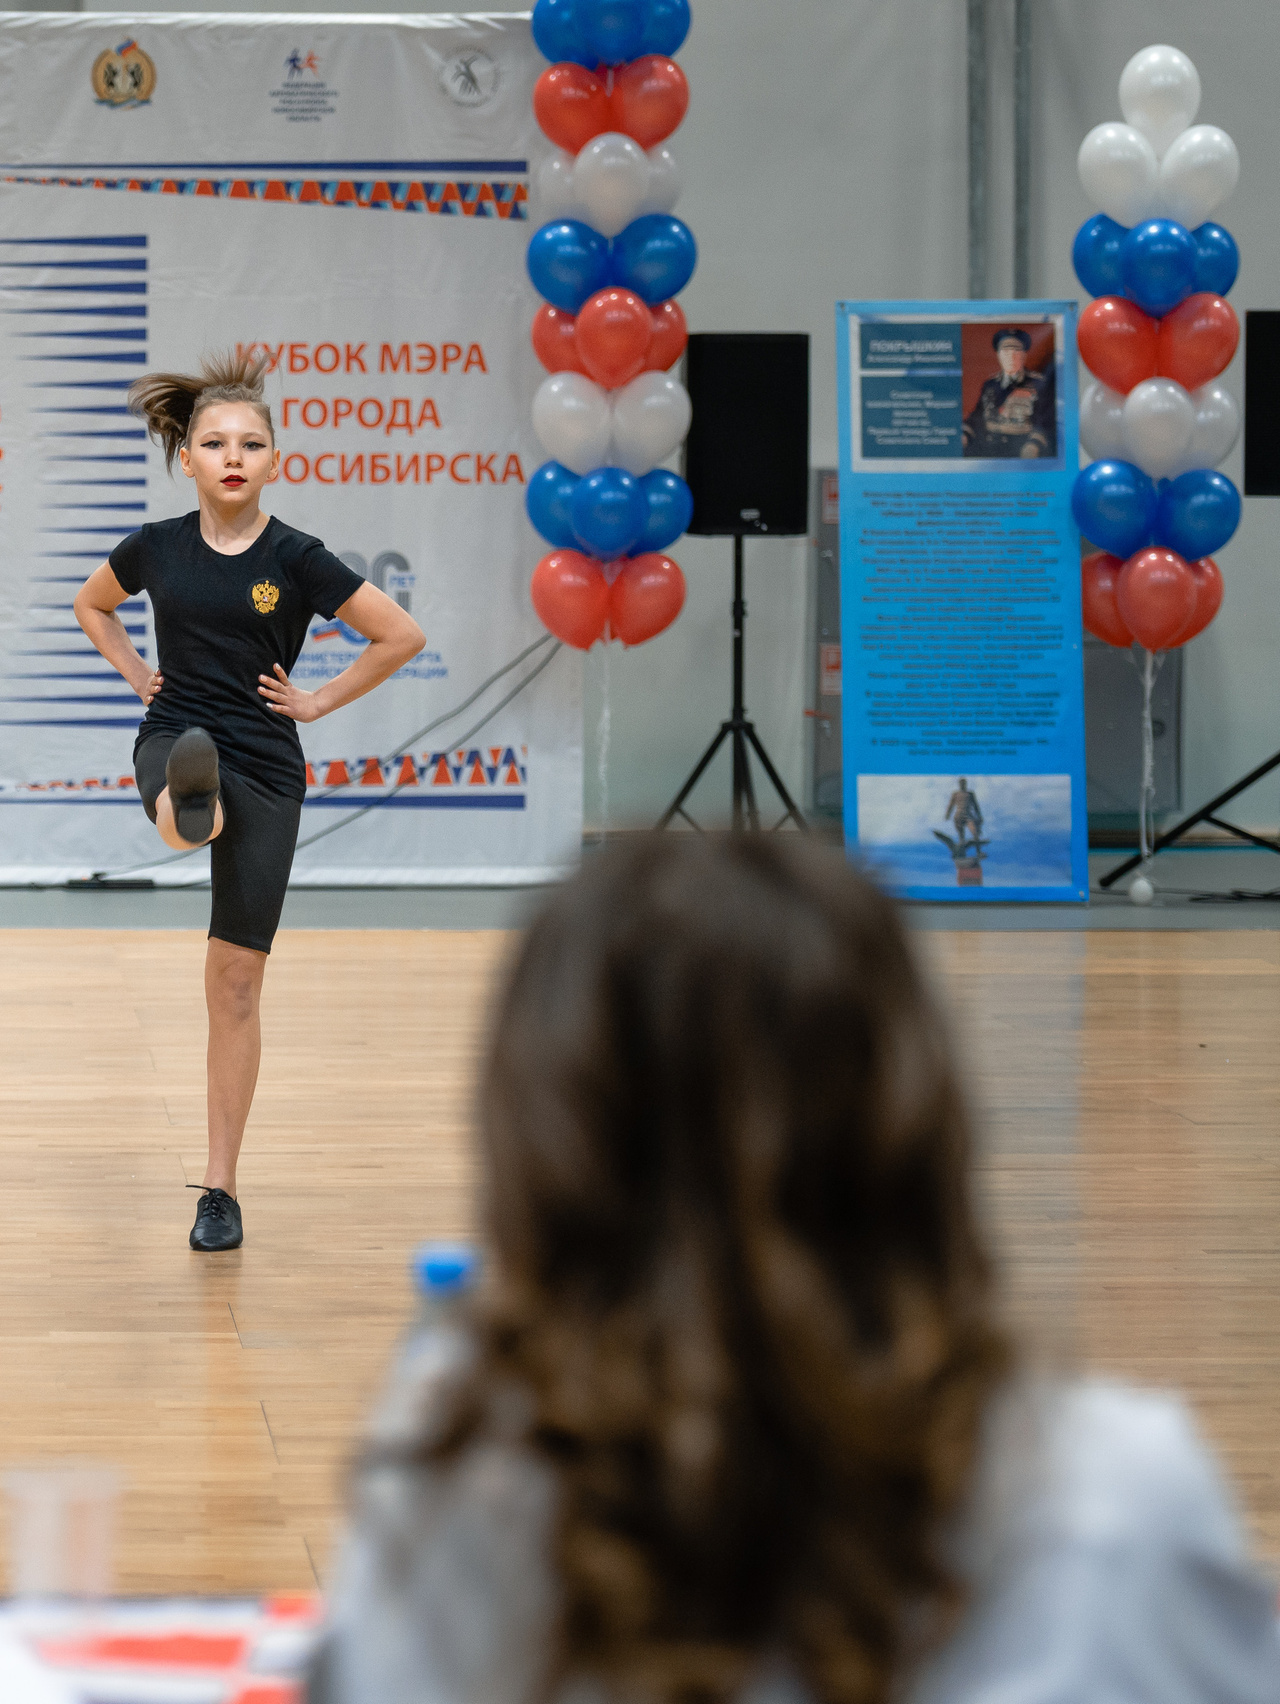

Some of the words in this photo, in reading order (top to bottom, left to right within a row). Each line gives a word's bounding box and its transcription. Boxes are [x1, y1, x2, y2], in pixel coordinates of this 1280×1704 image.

[378, 342, 489, 375] МЭРА
[281, 397, 443, 437] ГОРОДА
[266, 452, 527, 485] ОСИБИРСКА
